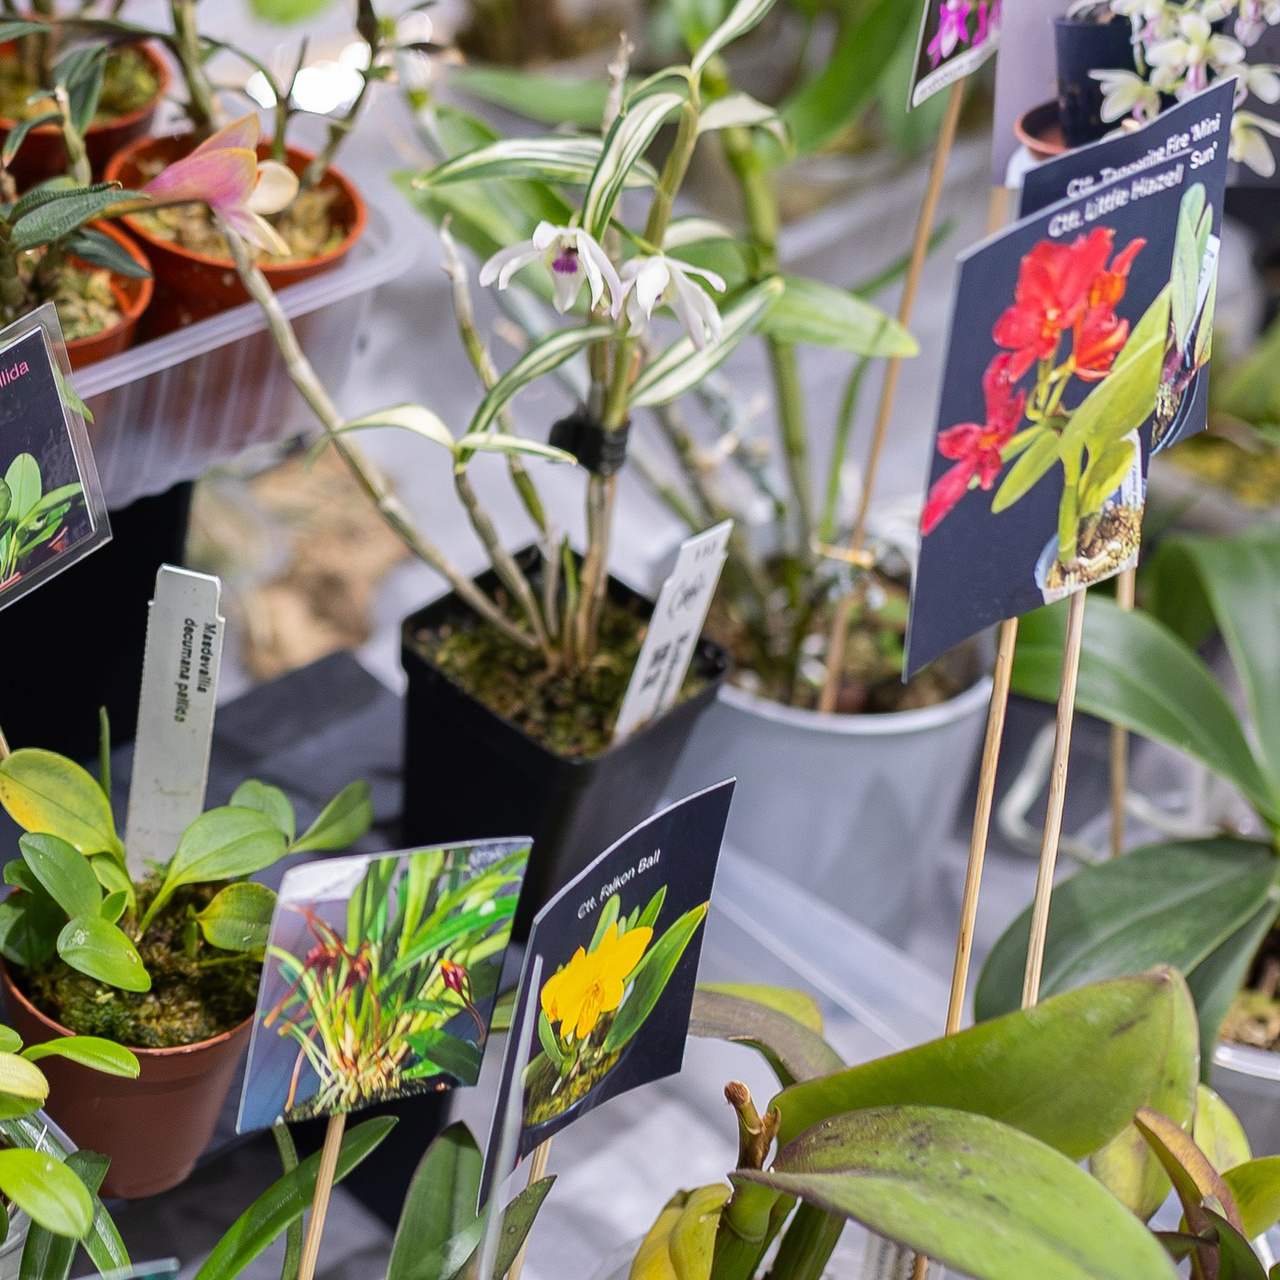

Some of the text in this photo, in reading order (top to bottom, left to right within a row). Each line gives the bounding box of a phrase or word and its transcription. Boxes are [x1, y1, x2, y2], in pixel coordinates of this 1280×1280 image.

[1084, 187, 1130, 221] Little
[1130, 163, 1185, 201] Hazel
[196, 622, 217, 694] Masdevallia
[637, 848, 661, 874] Ball
